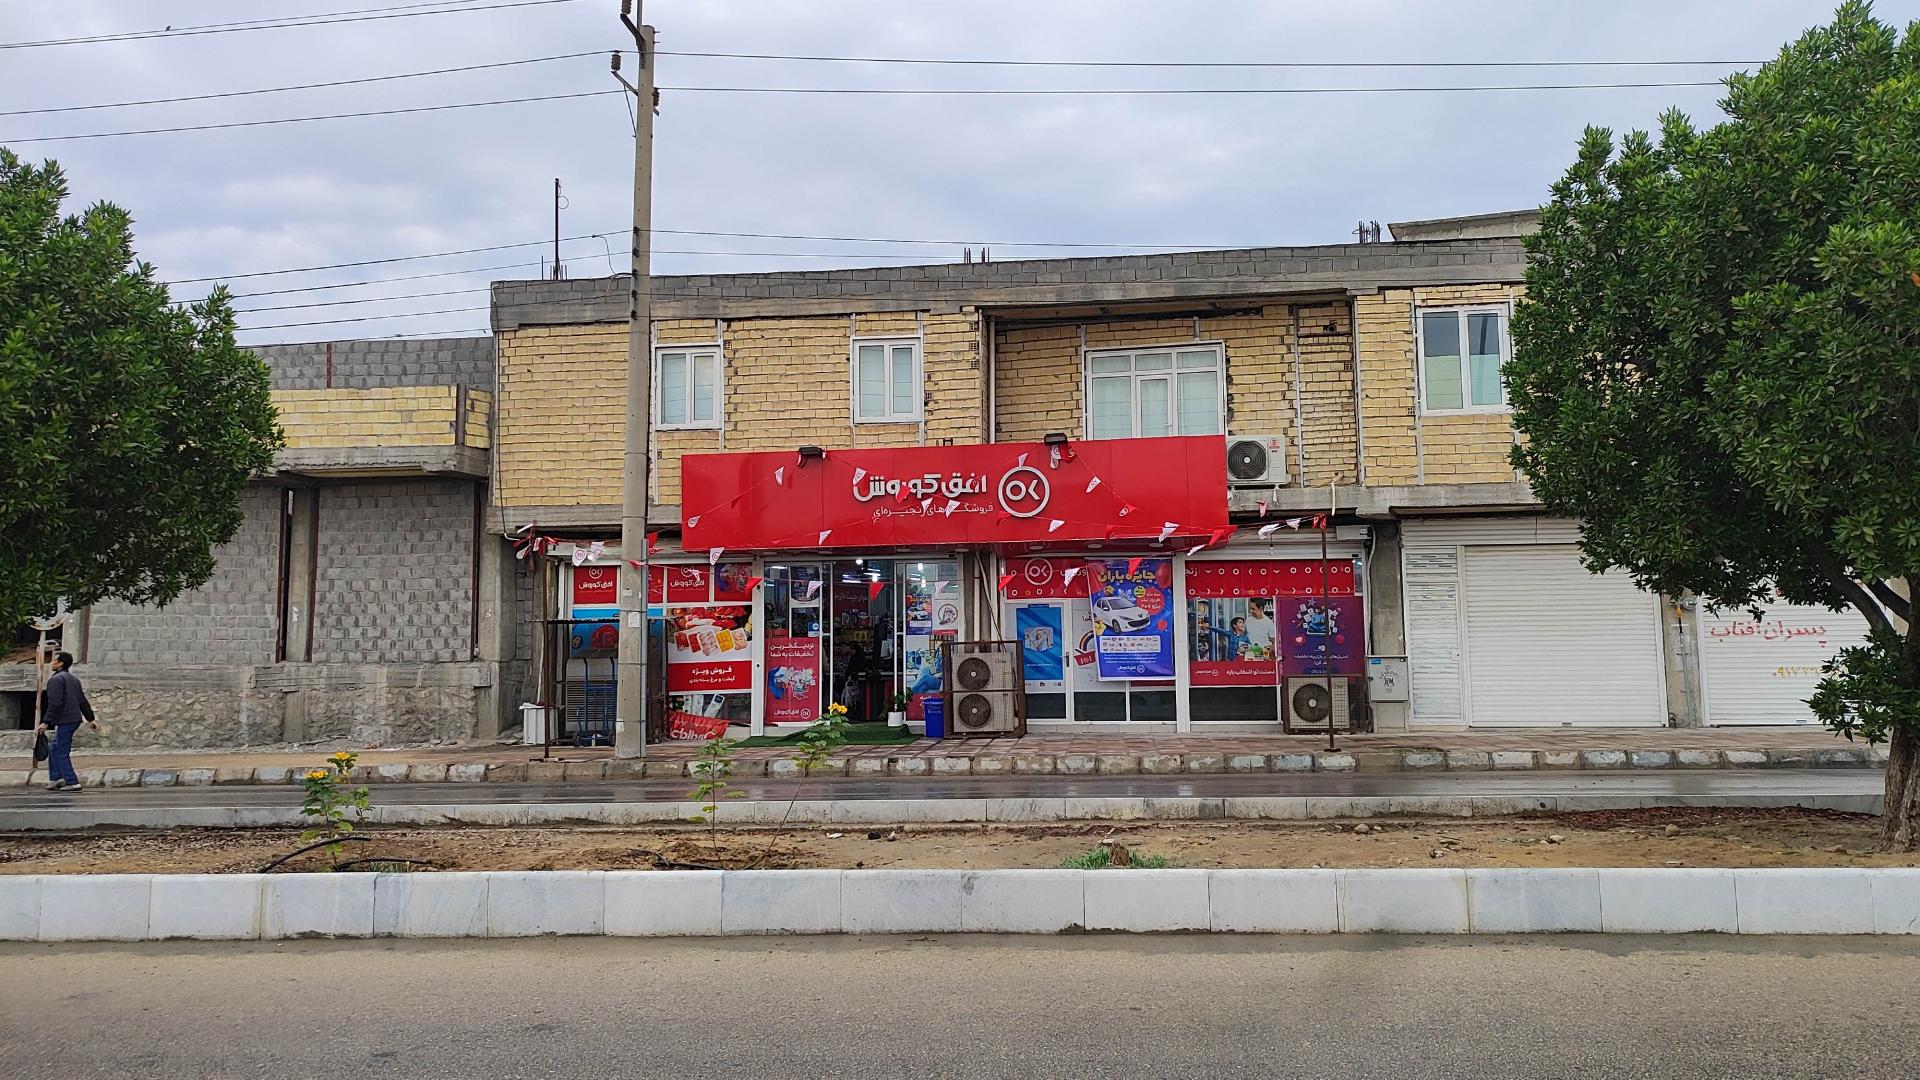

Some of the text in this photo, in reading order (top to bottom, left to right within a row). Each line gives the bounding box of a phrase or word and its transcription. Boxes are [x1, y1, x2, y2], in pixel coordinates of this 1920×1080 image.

[1764, 620, 1827, 648] پسران
[788, 650, 815, 658] تخفیفات
[691, 665, 733, 676] فروش ویژه
